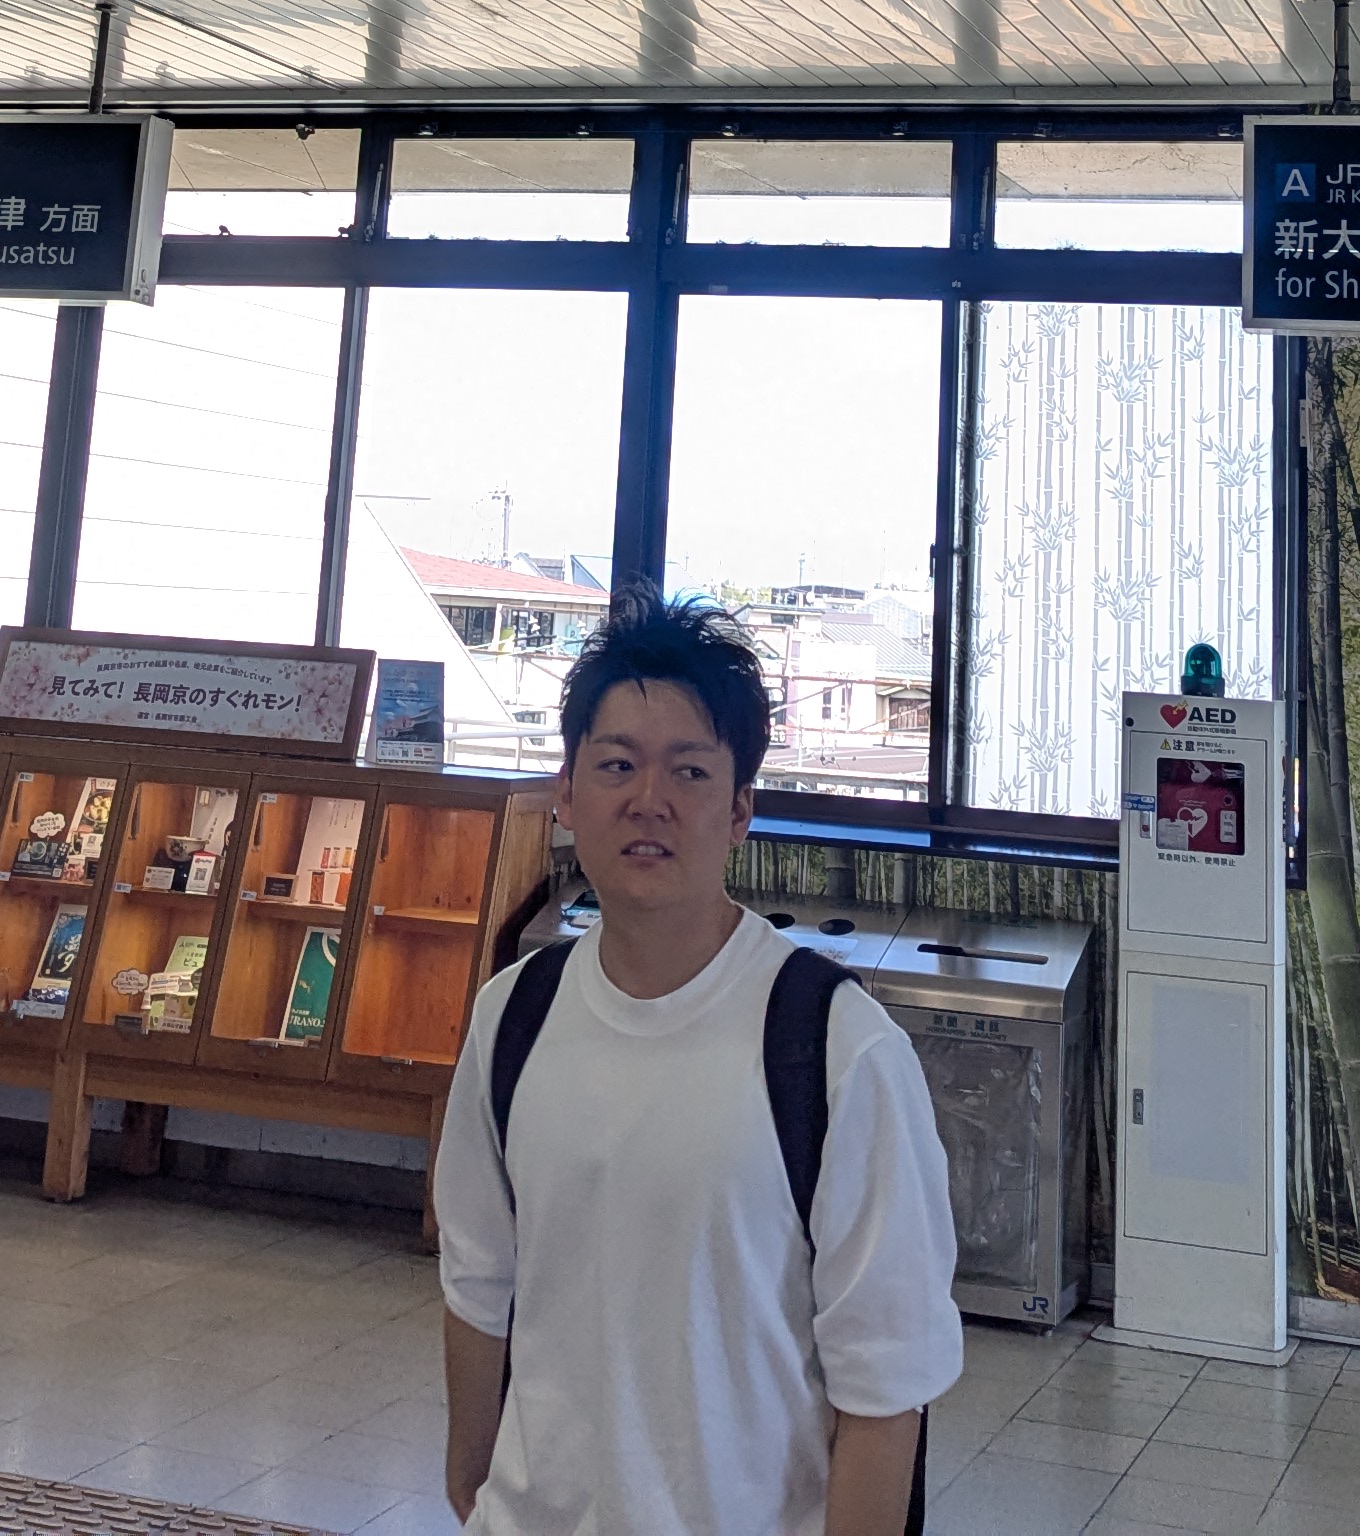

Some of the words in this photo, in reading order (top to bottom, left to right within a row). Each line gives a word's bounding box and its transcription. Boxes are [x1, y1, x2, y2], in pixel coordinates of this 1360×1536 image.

[1281, 168, 1311, 198] A
[1325, 189, 1348, 204] JR
[1275, 268, 1314, 299] for
[1188, 707, 1237, 724] AED
[1023, 1297, 1048, 1314] JR
